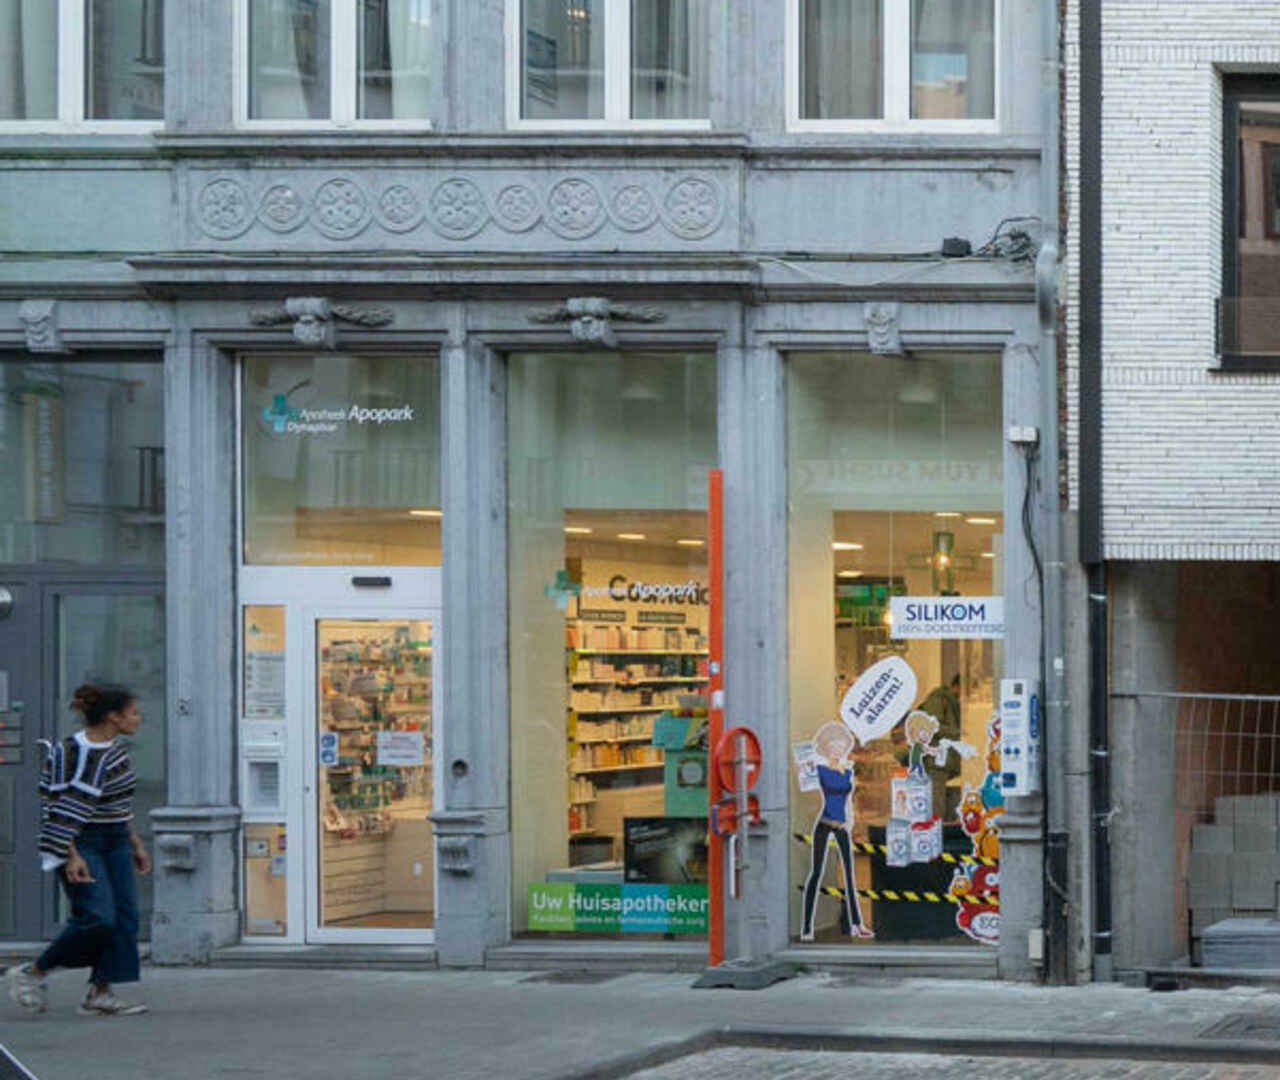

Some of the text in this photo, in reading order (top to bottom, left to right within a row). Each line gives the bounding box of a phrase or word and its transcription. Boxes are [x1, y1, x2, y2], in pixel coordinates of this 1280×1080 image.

[349, 404, 414, 424] Apopark
[906, 603, 985, 621] SILIKOM
[849, 667, 895, 719] Luizen-
[866, 676, 904, 725] alarm!
[532, 891, 710, 914] Uw Huisapotheker
